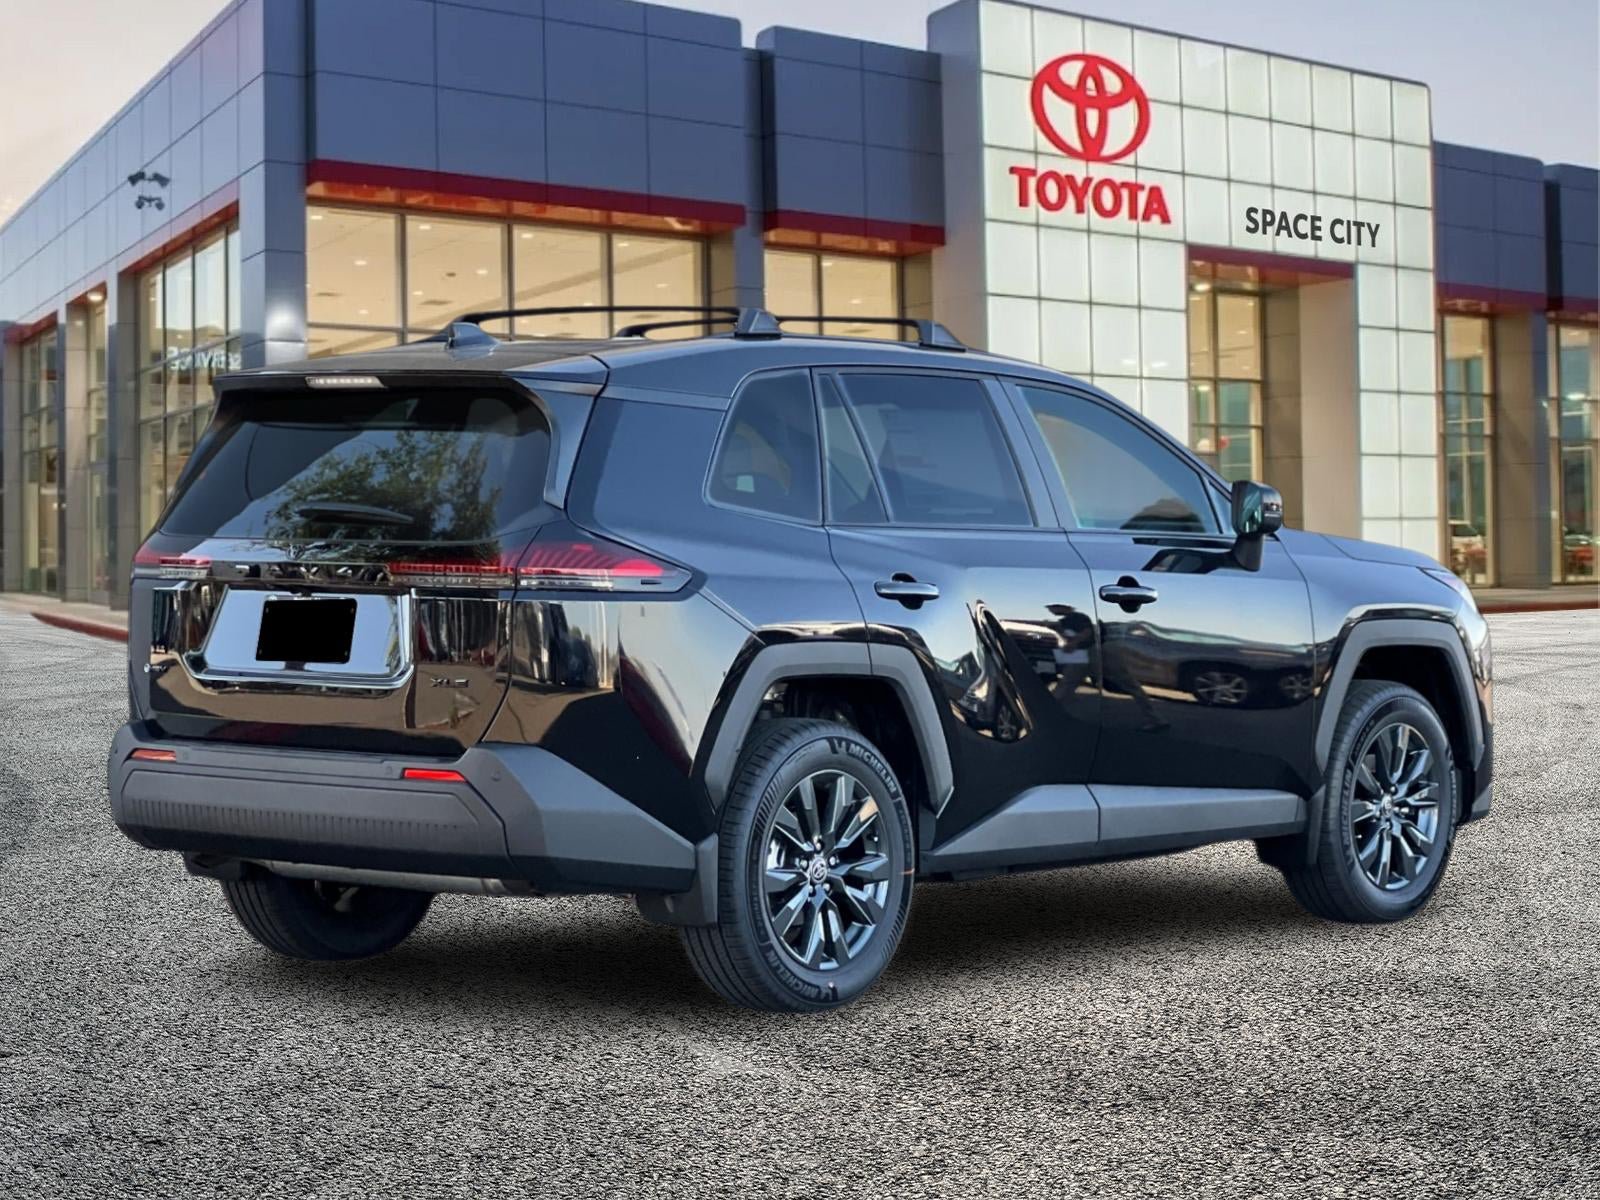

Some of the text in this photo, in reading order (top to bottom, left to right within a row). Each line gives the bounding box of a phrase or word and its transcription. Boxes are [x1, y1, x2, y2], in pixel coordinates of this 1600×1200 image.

[1009, 166, 1171, 225] TOYOTA
[1245, 206, 1381, 248] SPACE CITY
[848, 742, 897, 793] MICHELIN
